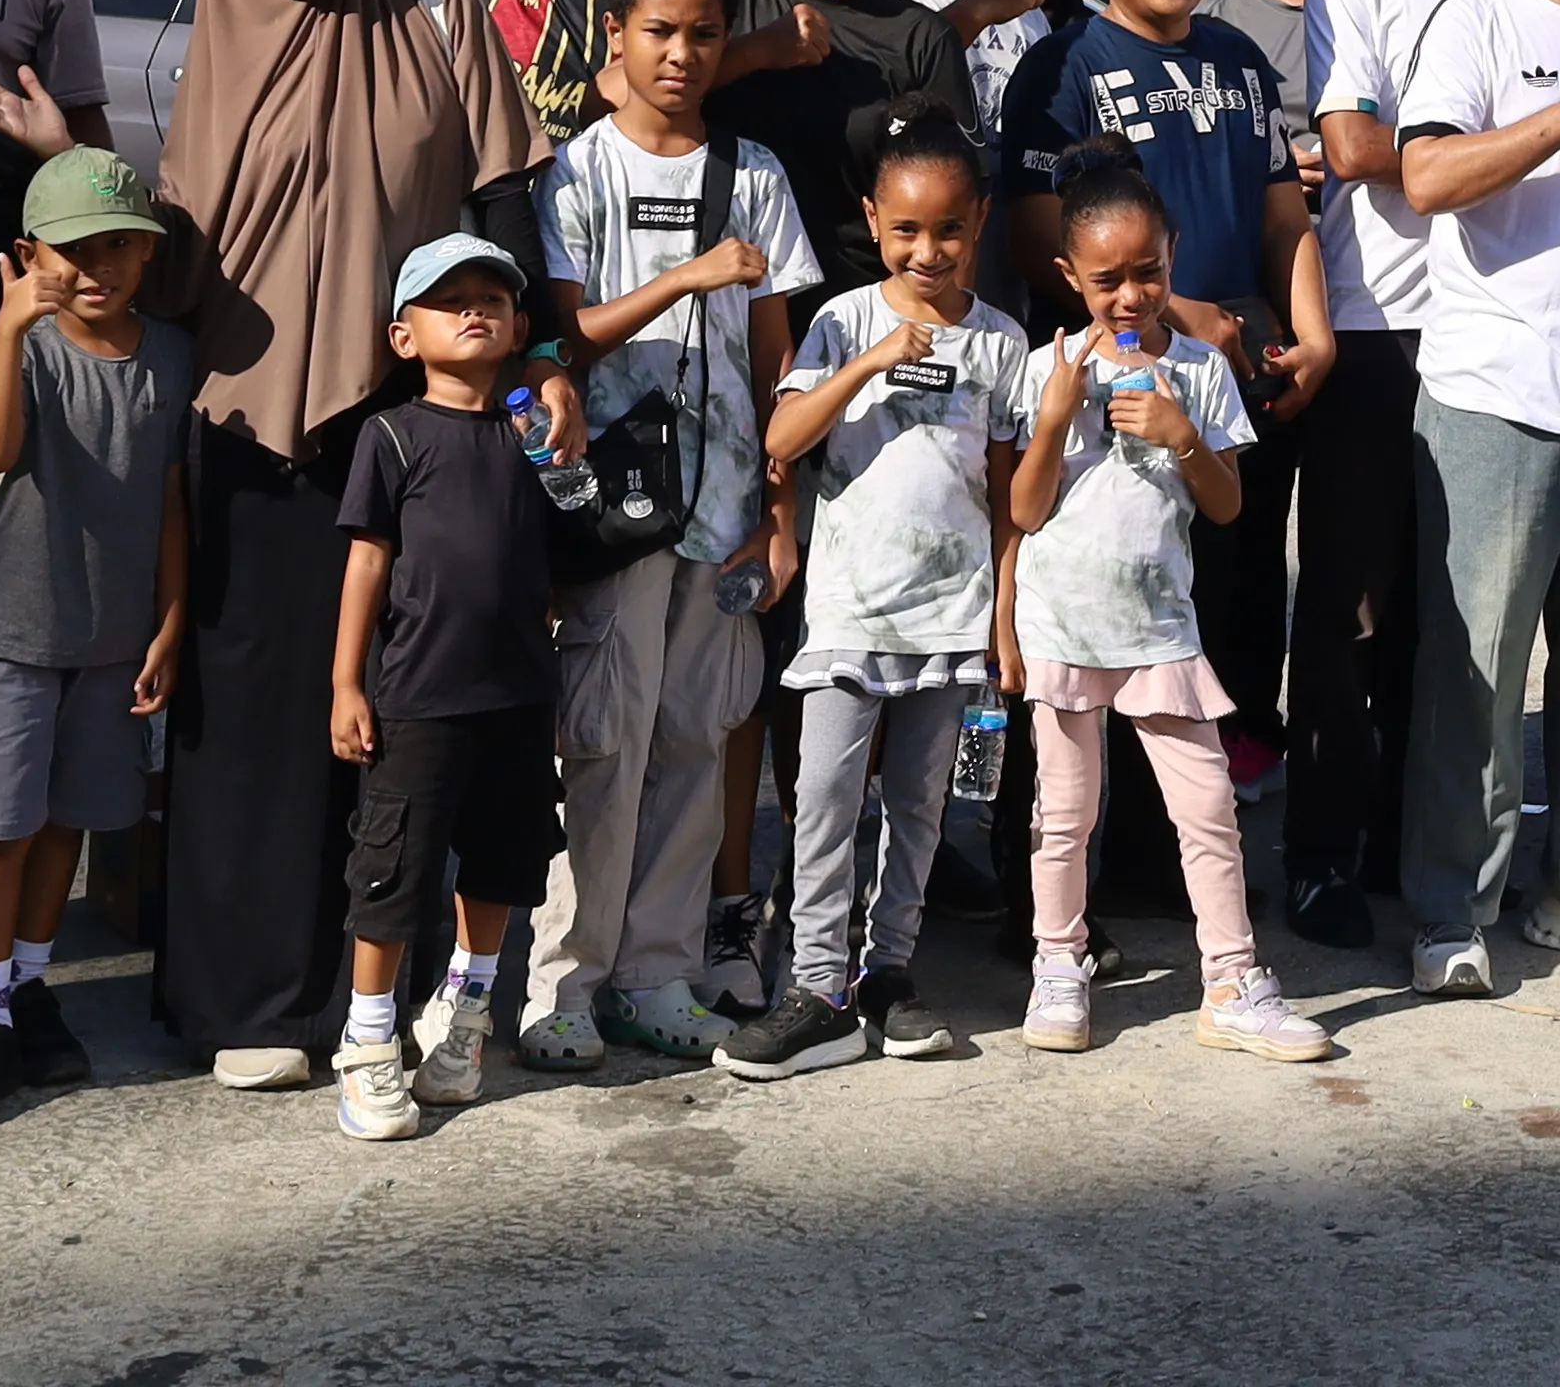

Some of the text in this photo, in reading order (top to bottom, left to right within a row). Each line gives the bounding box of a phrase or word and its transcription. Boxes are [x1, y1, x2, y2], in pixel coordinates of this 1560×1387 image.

[1145, 88, 1247, 115] STRAUSS
[637, 203, 686, 215] KINDNESS
[637, 212, 696, 224] CONTAGIOUS
[894, 363, 939, 377] KINDNESS
